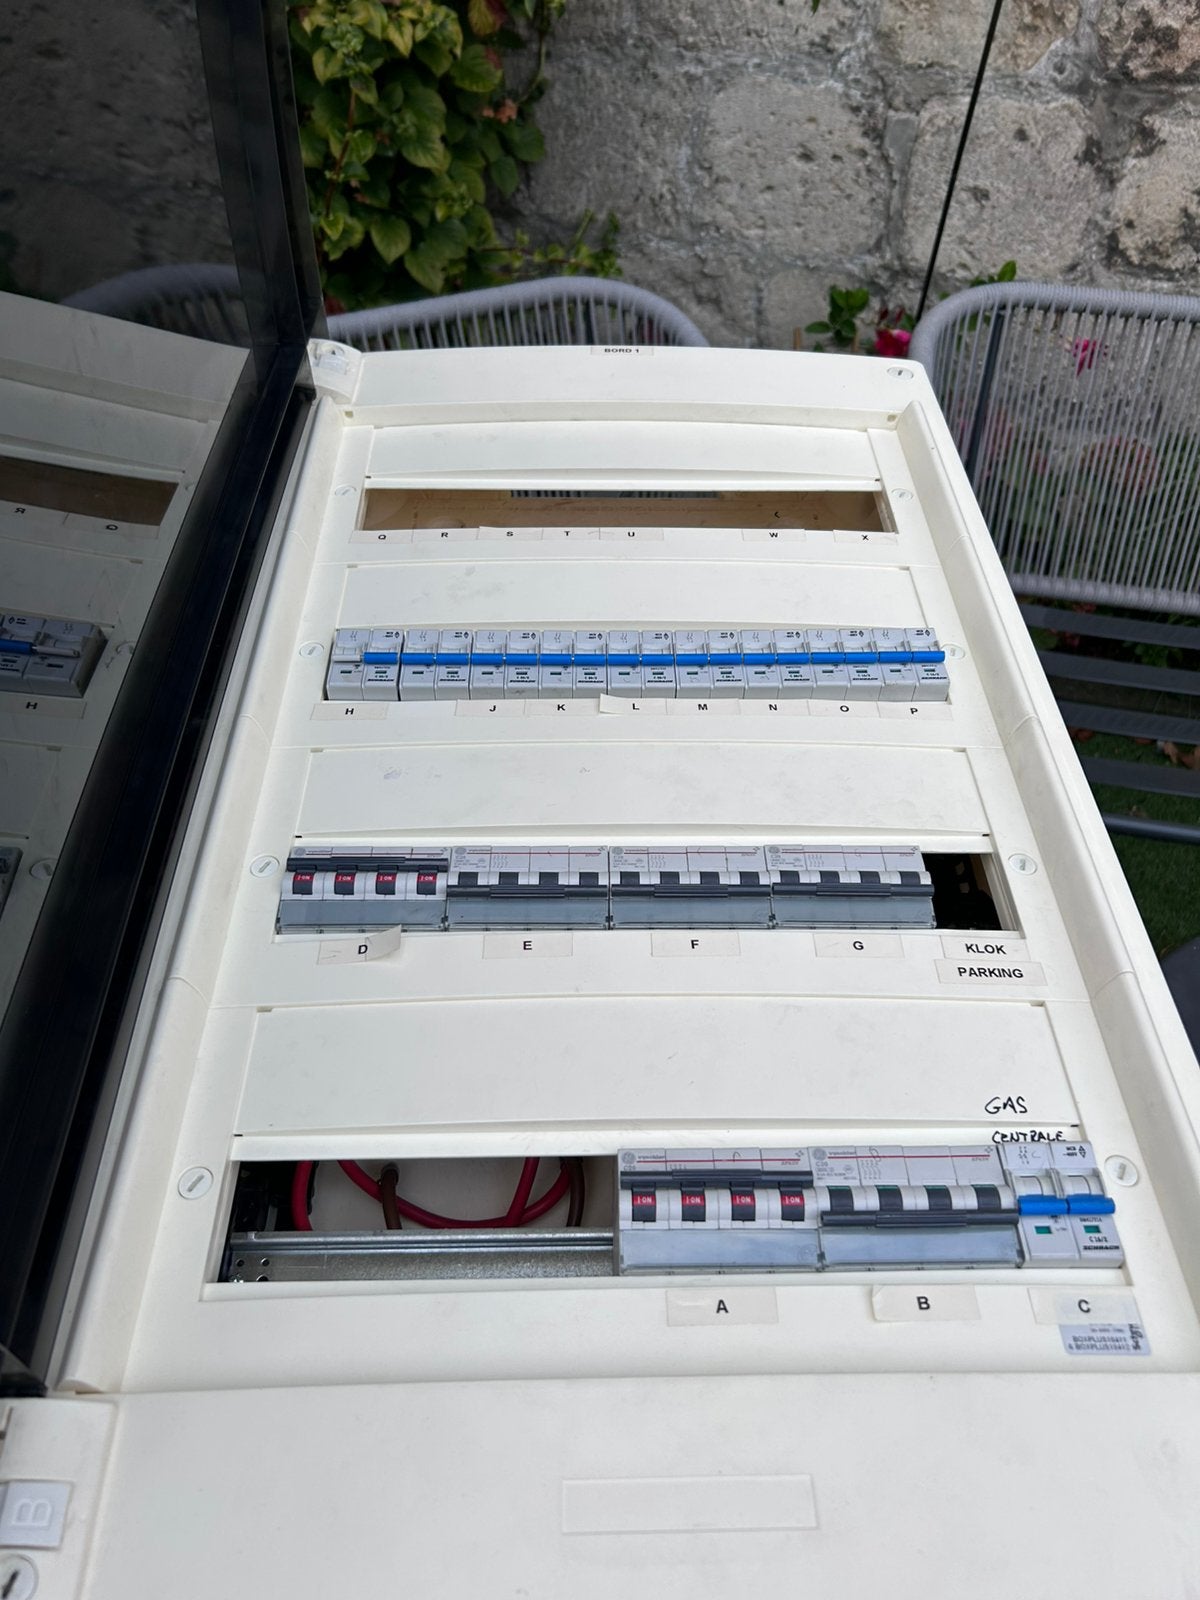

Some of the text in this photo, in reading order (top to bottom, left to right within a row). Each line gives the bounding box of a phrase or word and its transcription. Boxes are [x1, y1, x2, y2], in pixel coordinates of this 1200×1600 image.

[768, 531, 779, 539] W
[345, 704, 354, 715] H
[489, 704, 497, 712] J
[556, 703, 566, 712] K
[632, 702, 642, 711] L
[697, 703, 708, 712] M
[768, 703, 778, 712] N
[839, 704, 850, 713] O
[910, 707, 919, 715] P
[356, 944, 369, 956] D
[523, 940, 534, 951] E
[690, 940, 699, 950] F
[852, 940, 865, 951] G
[965, 943, 1007, 956] KLOK
[957, 966, 1025, 979] PARKING
[984, 1095, 1029, 1115] GAS
[716, 1299, 730, 1314] A
[916, 1296, 931, 1311] B
[1077, 1299, 1091, 1314] C
